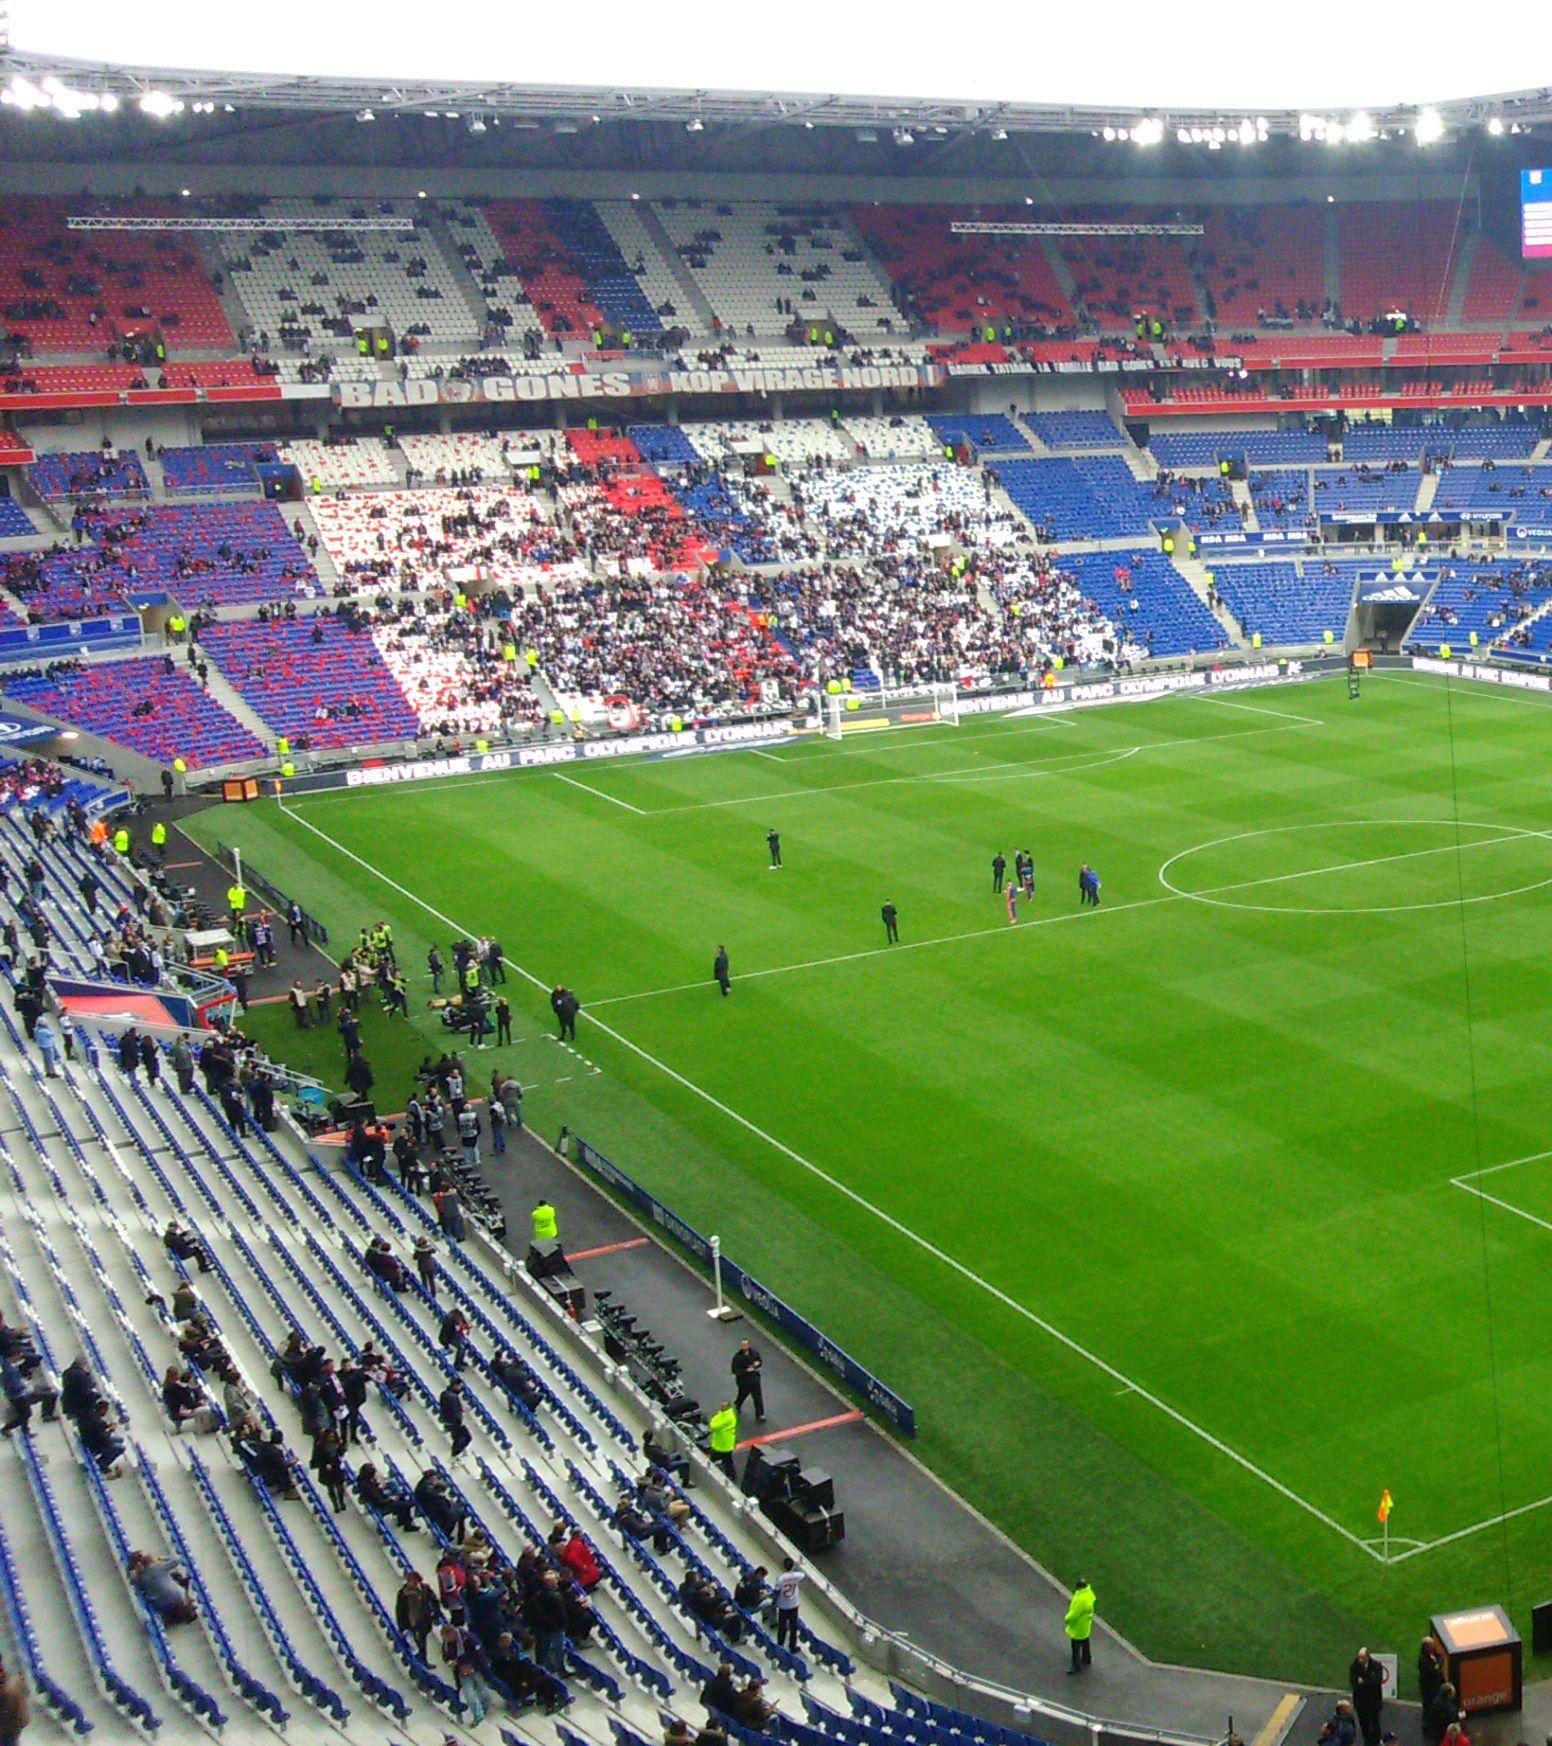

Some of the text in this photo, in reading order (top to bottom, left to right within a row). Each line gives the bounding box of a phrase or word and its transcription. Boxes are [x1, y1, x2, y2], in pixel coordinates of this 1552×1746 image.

[340, 372, 631, 407] BAD GONES
[670, 365, 919, 393] KOP VIRAGE NORD
[1039, 689, 1065, 704] AU
[1071, 683, 1115, 701] PARC
[346, 757, 471, 786] BIENVENUE
[481, 753, 511, 770] AU
[520, 746, 576, 765] PARC
[584, 730, 697, 759] OLYMPIQUE
[704, 720, 794, 744] LYONNAIS
